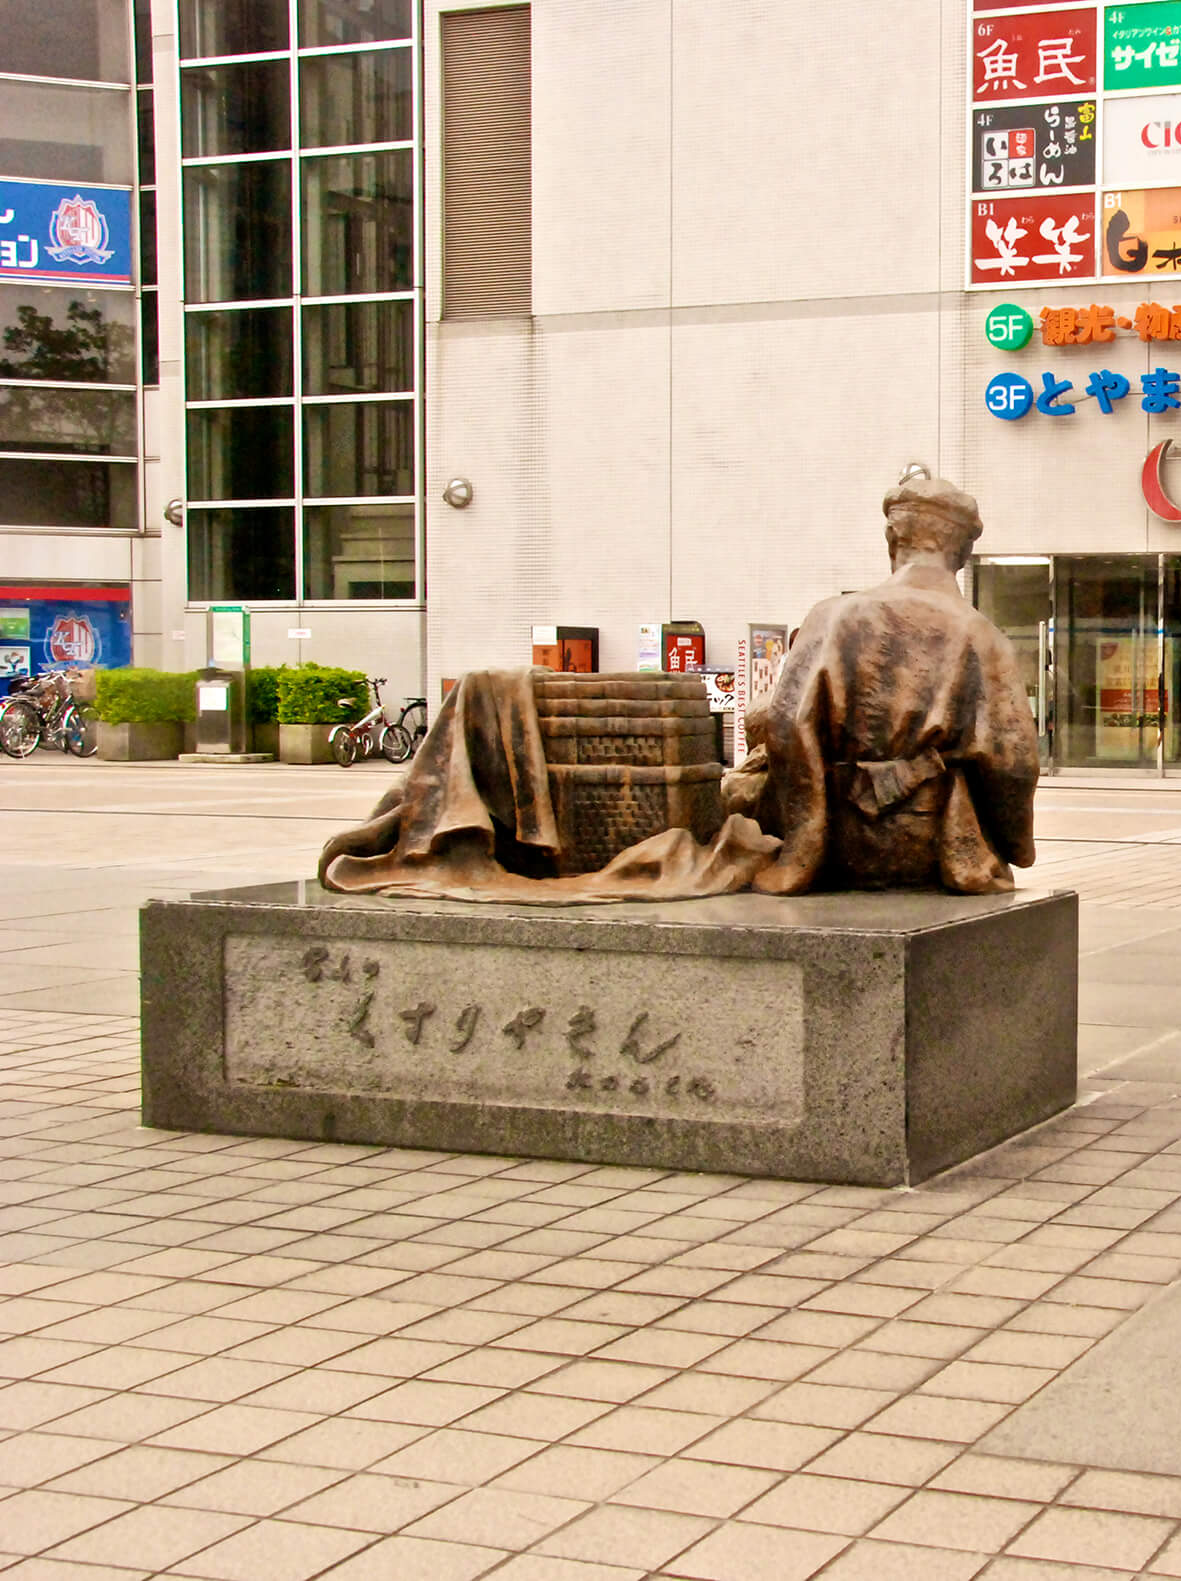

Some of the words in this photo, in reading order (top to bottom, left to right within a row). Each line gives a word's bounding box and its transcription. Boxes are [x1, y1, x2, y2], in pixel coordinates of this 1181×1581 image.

[978, 24, 994, 36] 6F
[976, 37, 1088, 93] 魚民
[977, 113, 994, 126] 4F
[1077, 102, 1096, 141] 富山
[1040, 106, 1064, 185] らーめん
[978, 203, 994, 216] B1
[1104, 193, 1122, 208] B1
[974, 215, 1090, 276] 笑笑
[988, 315, 1024, 338] 5F
[988, 385, 1026, 411] 3F
